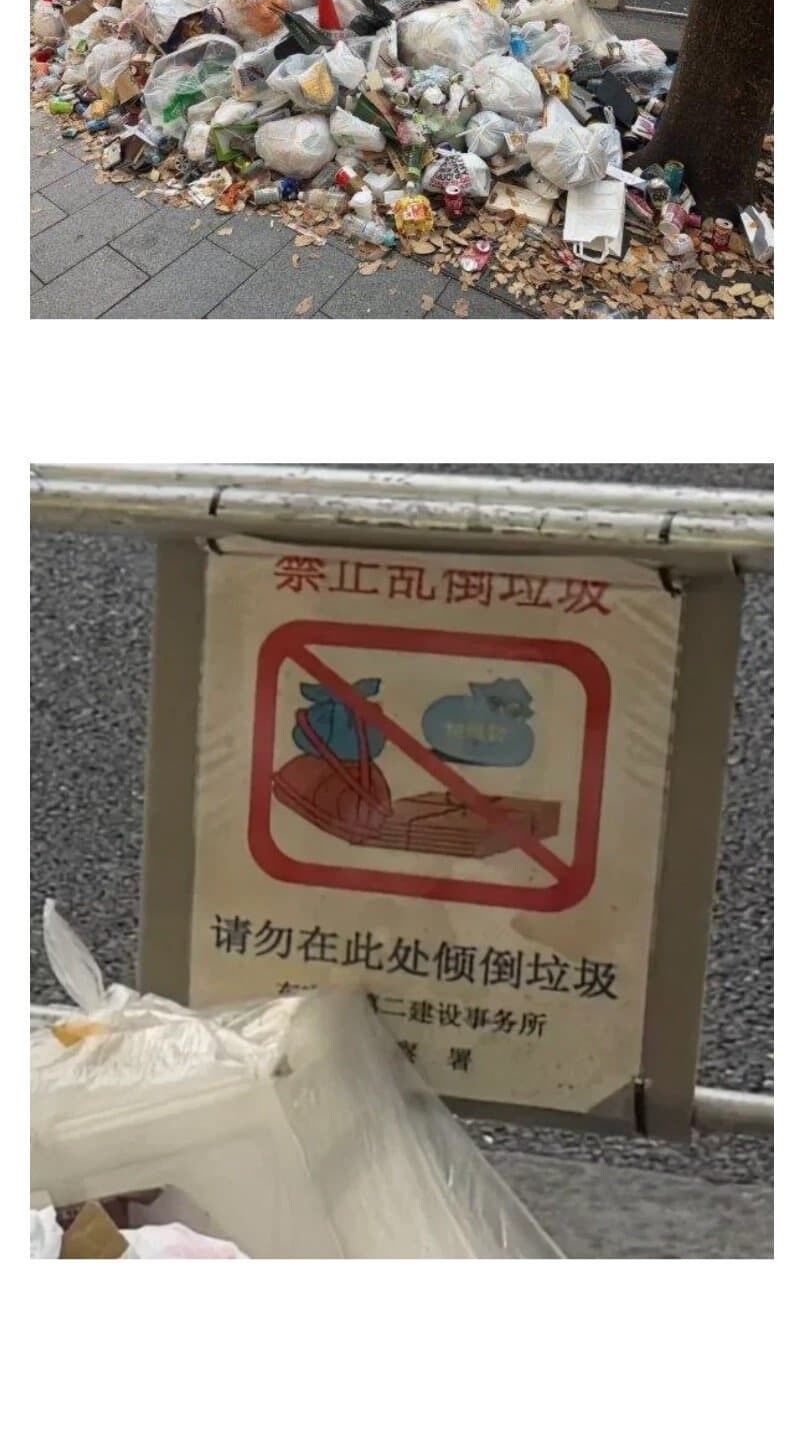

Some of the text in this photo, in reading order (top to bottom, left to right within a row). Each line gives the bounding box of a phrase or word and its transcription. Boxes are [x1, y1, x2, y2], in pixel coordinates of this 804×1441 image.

[209, 913, 619, 1001] 请勿在此处倾倒垃圾
